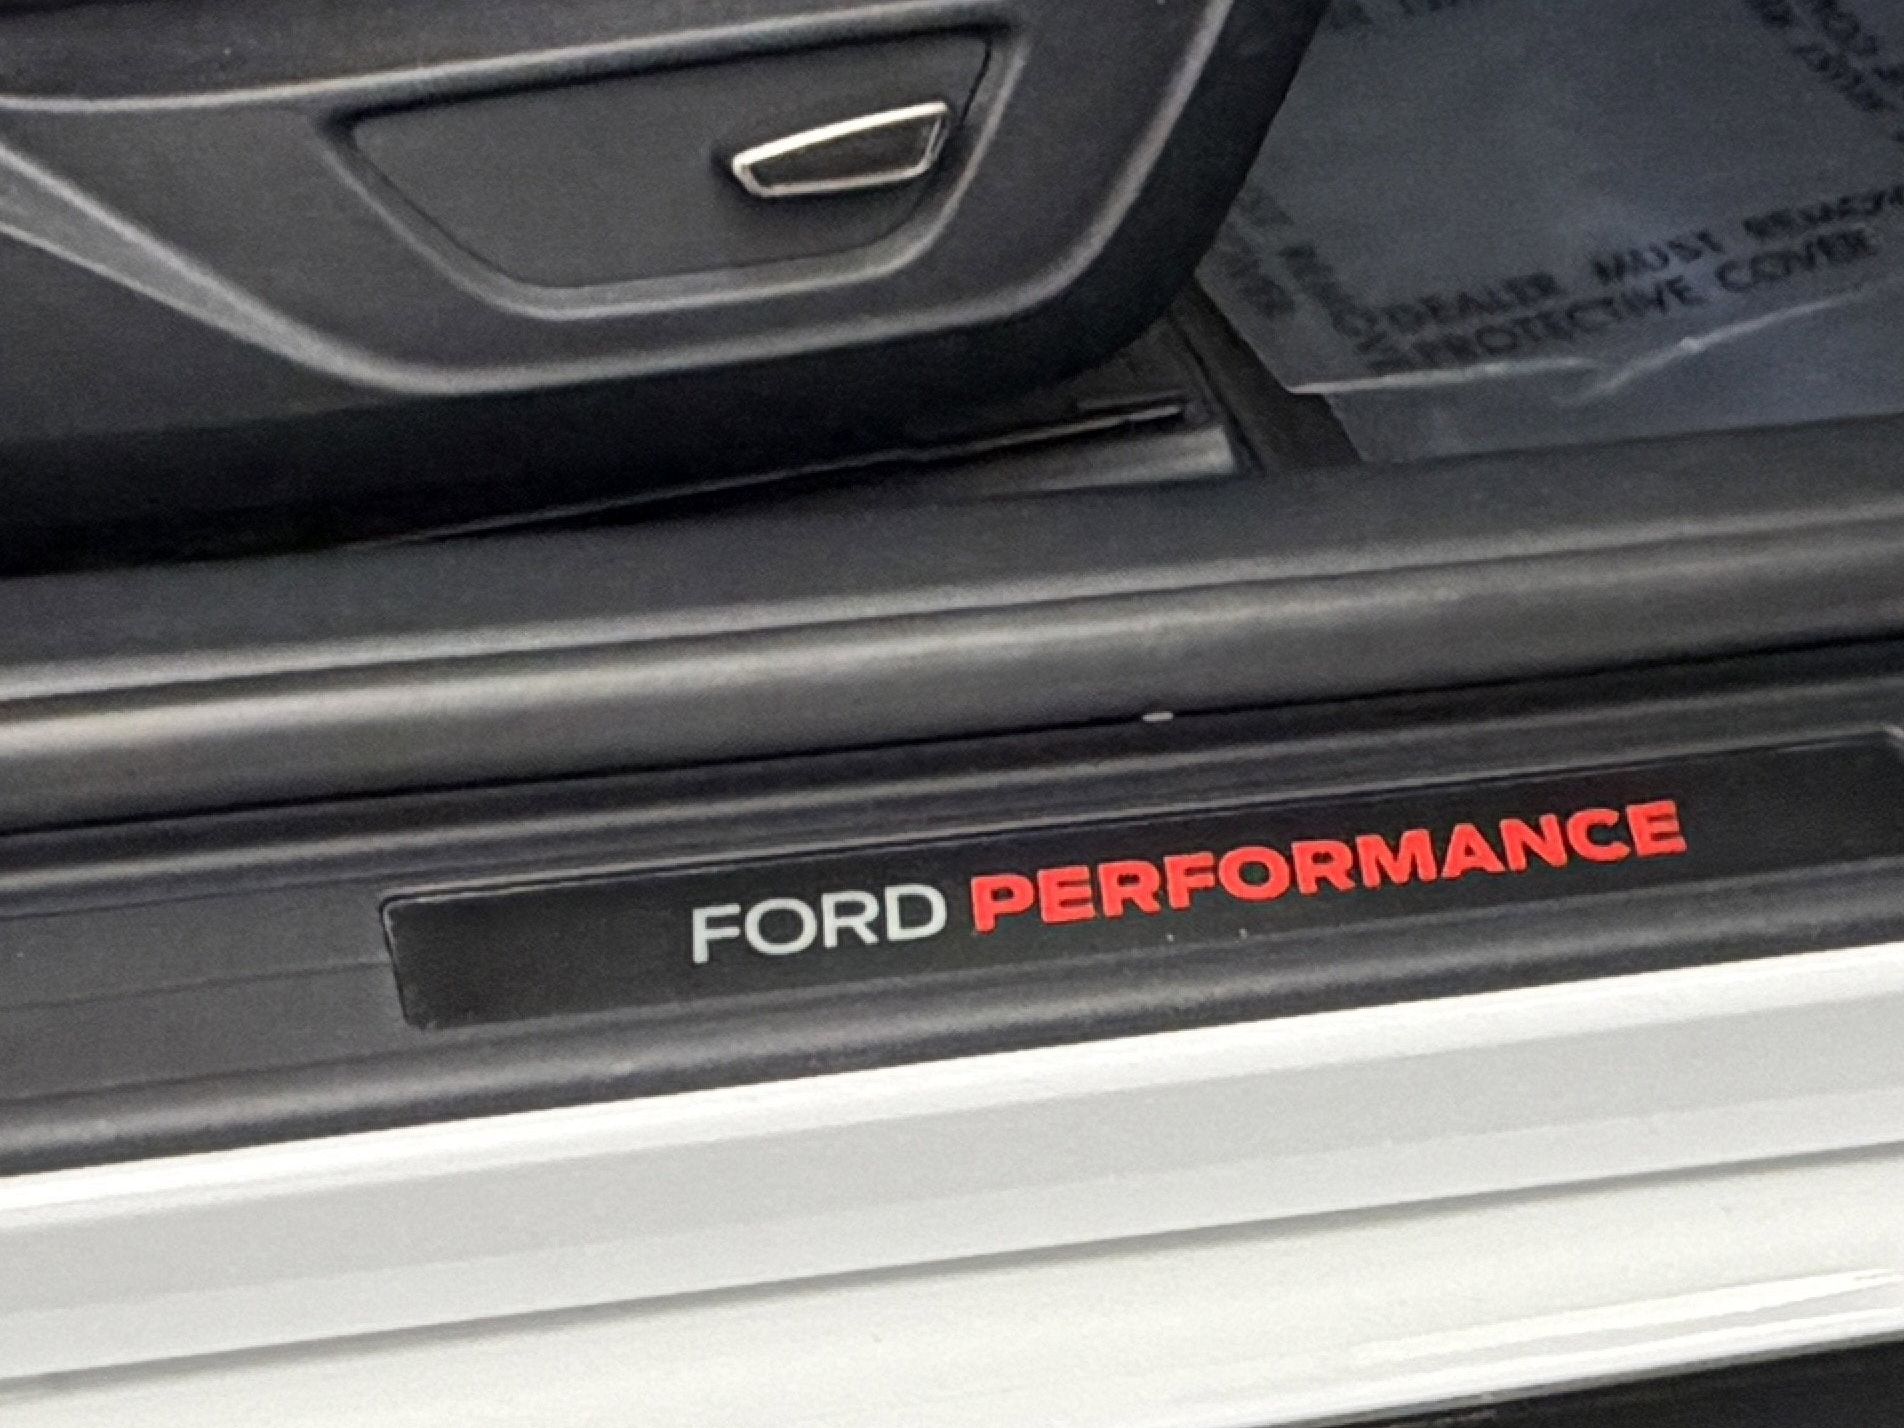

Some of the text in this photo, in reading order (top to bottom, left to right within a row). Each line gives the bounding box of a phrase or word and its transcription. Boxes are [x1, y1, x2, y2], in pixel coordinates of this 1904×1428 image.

[1412, 228, 1882, 361] PROTECTIVE COVER
[1590, 229, 1728, 285] MUST
[690, 800, 1686, 965] FORD PERFORMANCE
